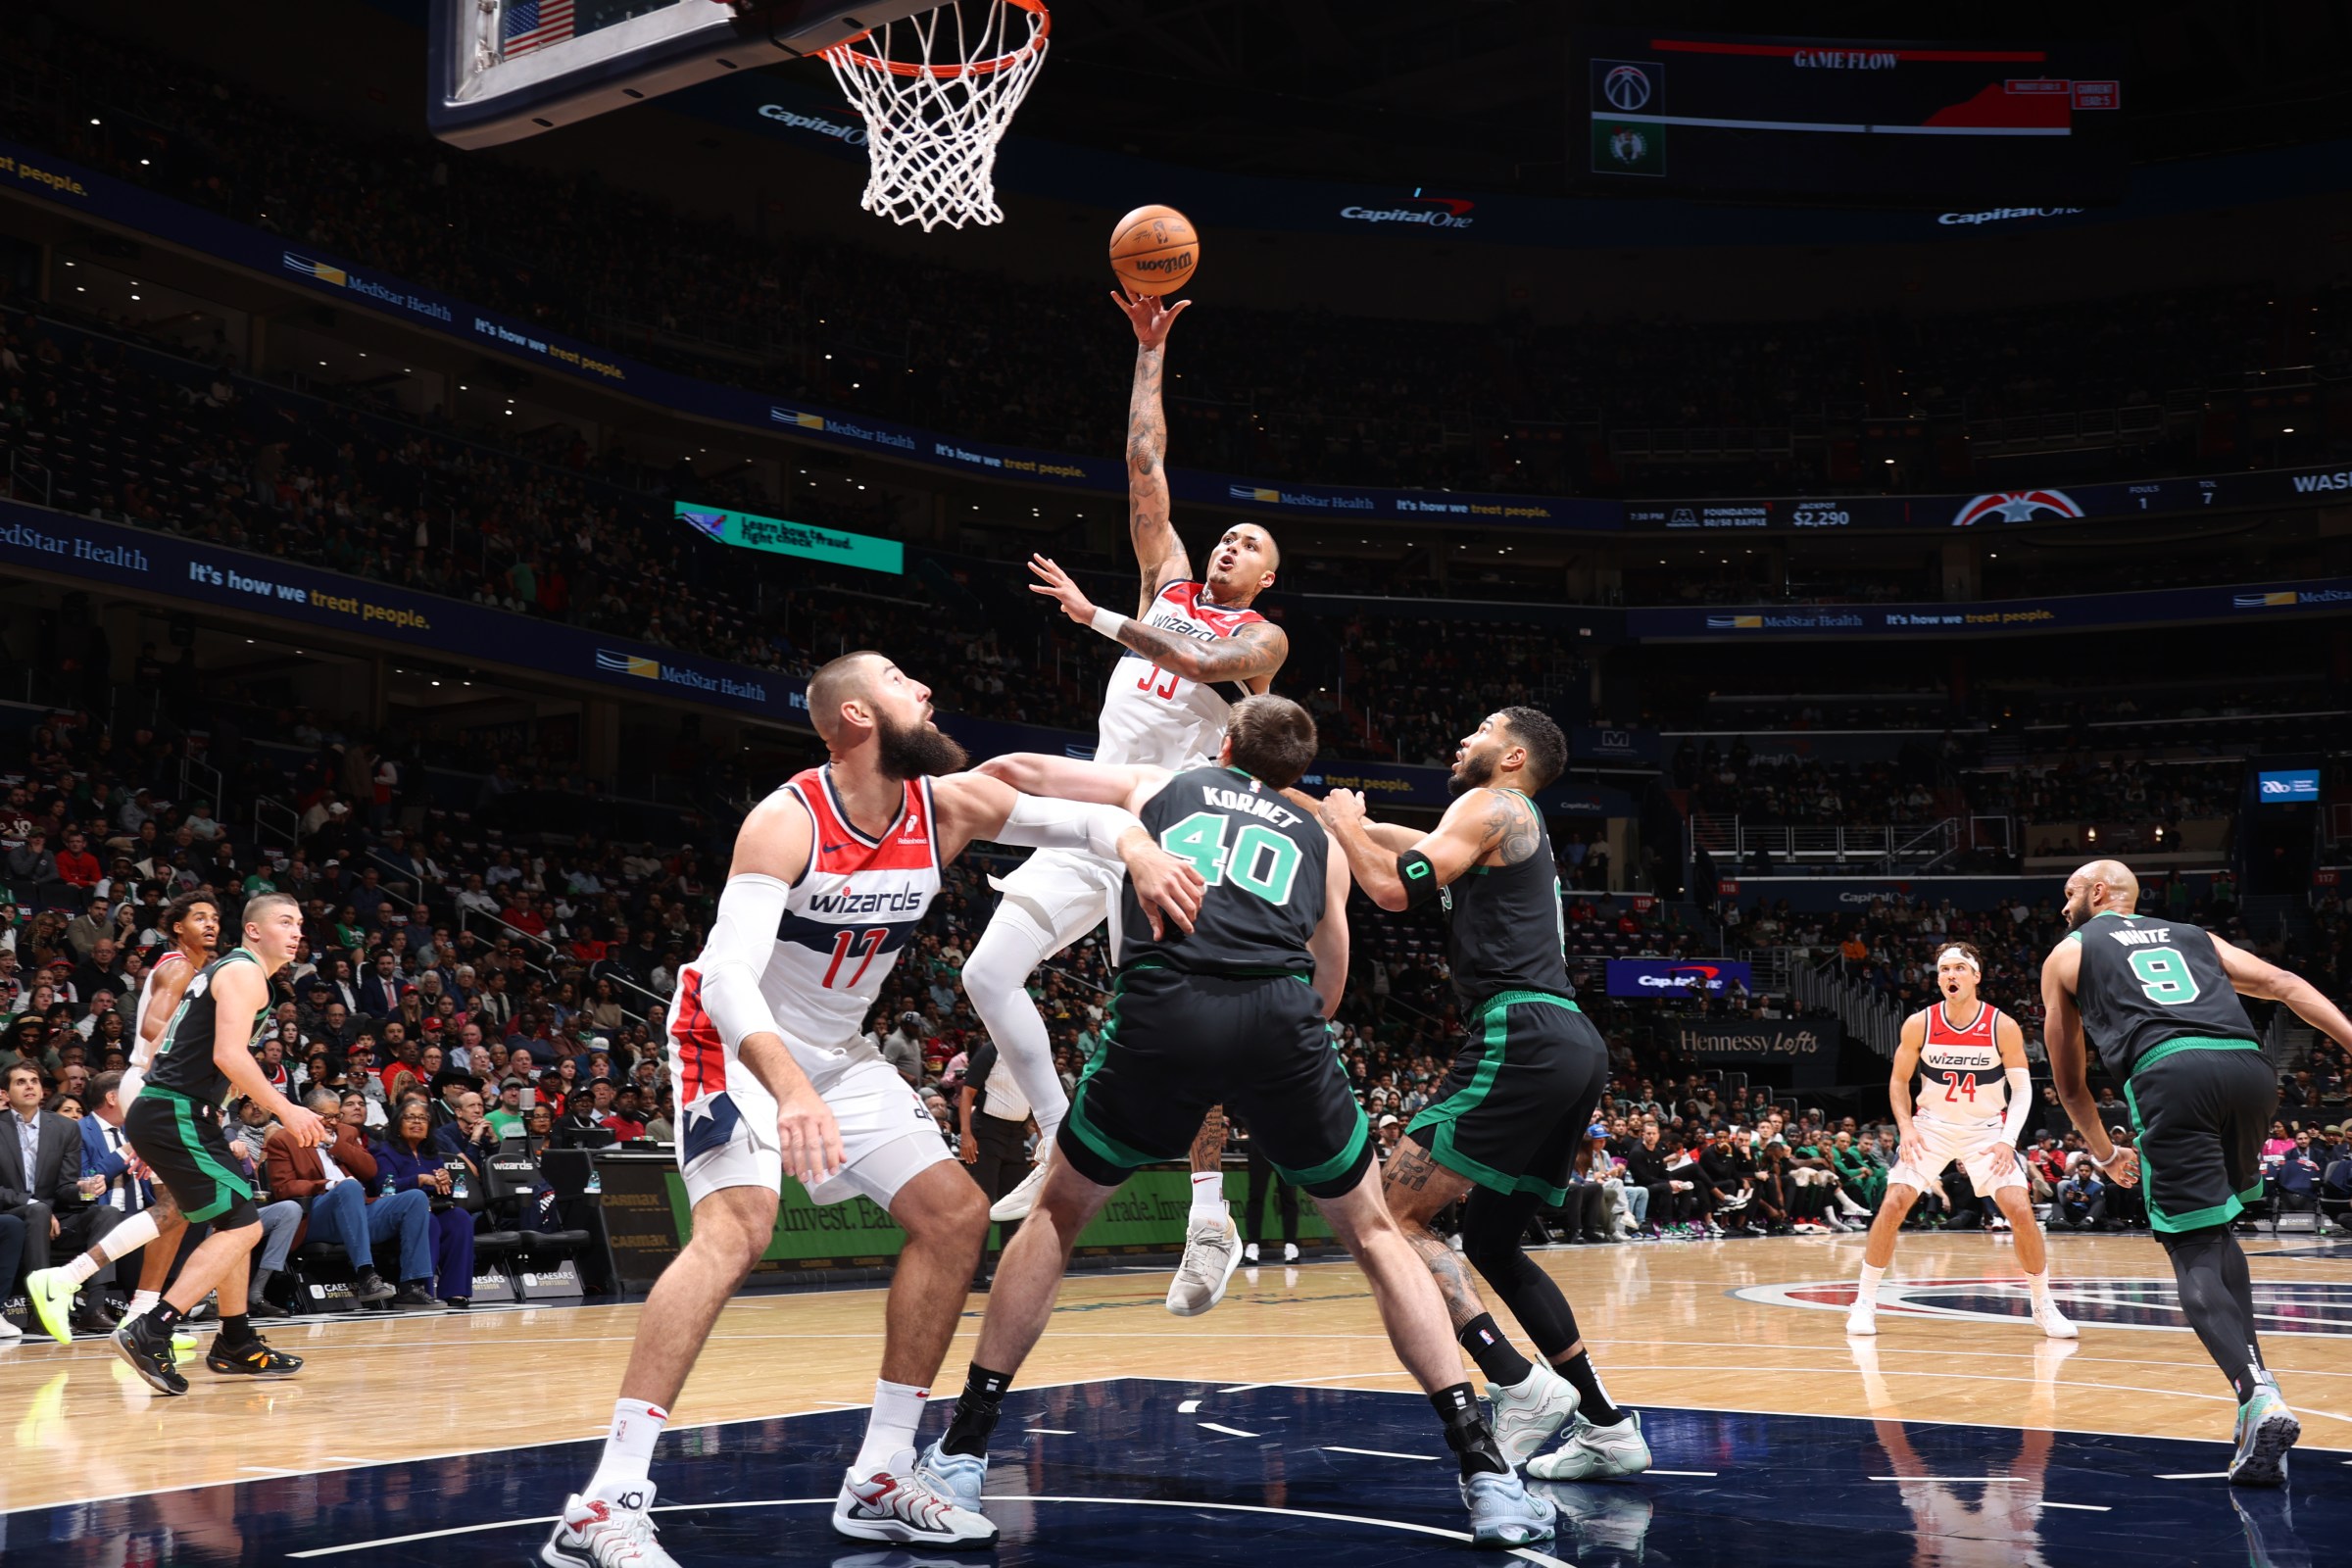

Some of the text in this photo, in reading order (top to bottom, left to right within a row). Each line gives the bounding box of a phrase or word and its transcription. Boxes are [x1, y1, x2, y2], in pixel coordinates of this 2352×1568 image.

[1793, 50, 1899, 70] GAME FLOW
[19, 163, 89, 196] people.
[1136, 251, 1193, 274] Wilson
[347, 275, 404, 307] MedStar
[407, 294, 452, 322] Health
[474, 317, 497, 336] It's
[498, 324, 525, 346] how
[527, 338, 547, 354] we
[549, 344, 580, 365] treat
[824, 419, 874, 441] MedStar
[876, 431, 915, 451] Health
[956, 447, 982, 464] how
[983, 454, 1002, 467] we
[1003, 457, 1036, 471] treat
[1280, 492, 1331, 509] MedStar
[1332, 496, 1374, 511] Health
[1419, 501, 1447, 514] how
[1449, 504, 1469, 514] we
[2138, 492, 2215, 510] 1 7
[1792, 511, 1851, 528] $2,290
[0, 524, 431, 631] edStar Health It's how we treat people.
[1764, 615, 1817, 628] MedStar
[1818, 614, 1864, 627] Health
[1910, 613, 1939, 625] how
[1941, 614, 1964, 626] we
[1965, 611, 2000, 624] treat
[661, 664, 719, 692] MedStar
[720, 677, 766, 703] Health
[1201, 785, 1303, 829] KORNET
[1160, 811, 1303, 906] 40
[809, 880, 923, 914] wizards
[2109, 928, 2172, 947] WHITE
[821, 927, 890, 990] 17
[2128, 946, 2201, 1005] 9
[1681, 1030, 1821, 1055] Hennessy Lofts
[1929, 1052, 1991, 1067] wizards
[1942, 1071, 1977, 1103] 24
[492, 1159, 534, 1171] wizards
[471, 1275, 505, 1285] AESARS
[536, 1272, 574, 1281] CAESARS
